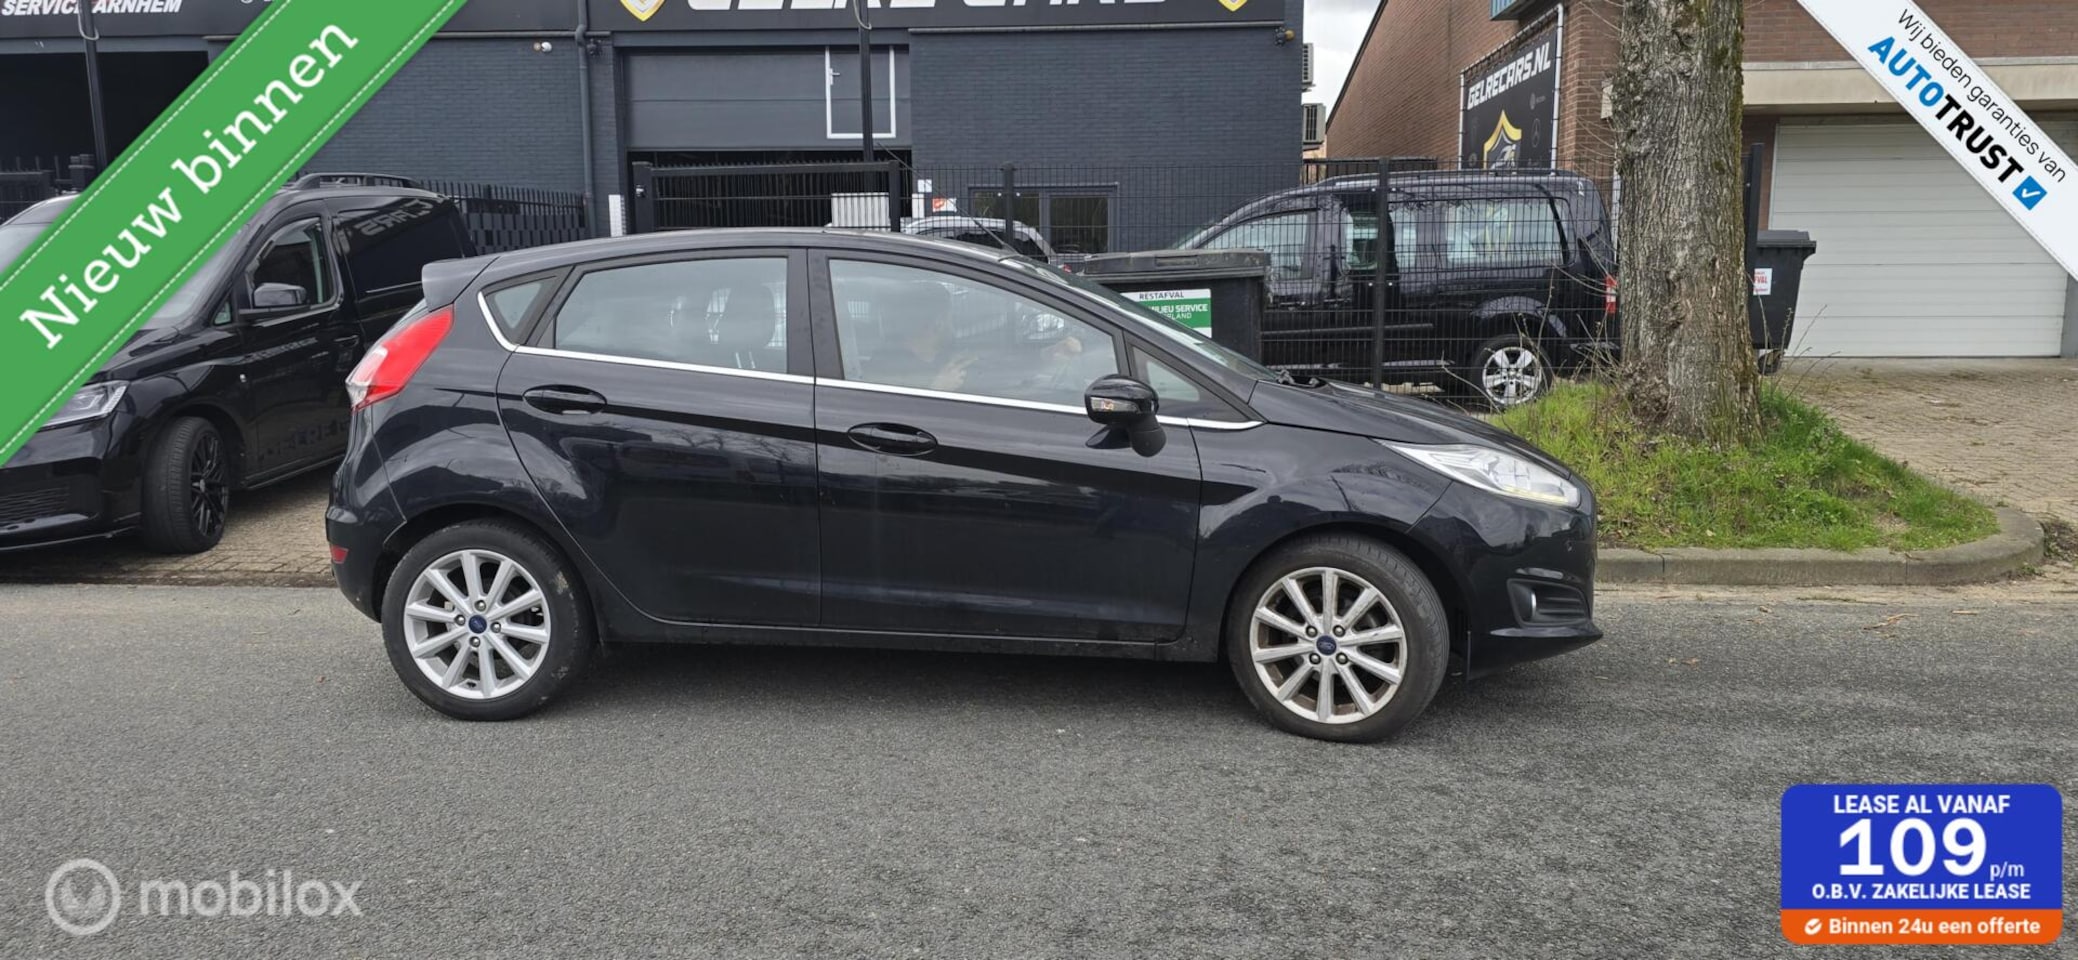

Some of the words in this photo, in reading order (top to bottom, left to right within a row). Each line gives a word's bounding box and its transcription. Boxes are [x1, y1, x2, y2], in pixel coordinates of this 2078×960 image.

[1, 0, 79, 16] SERVIC
[92, 0, 182, 13] ARNHEM
[1467, 41, 1551, 110] GELRECARS.NL
[1139, 291, 1185, 300] RESTAFVAL
[1175, 303, 1209, 313] SERVICE
